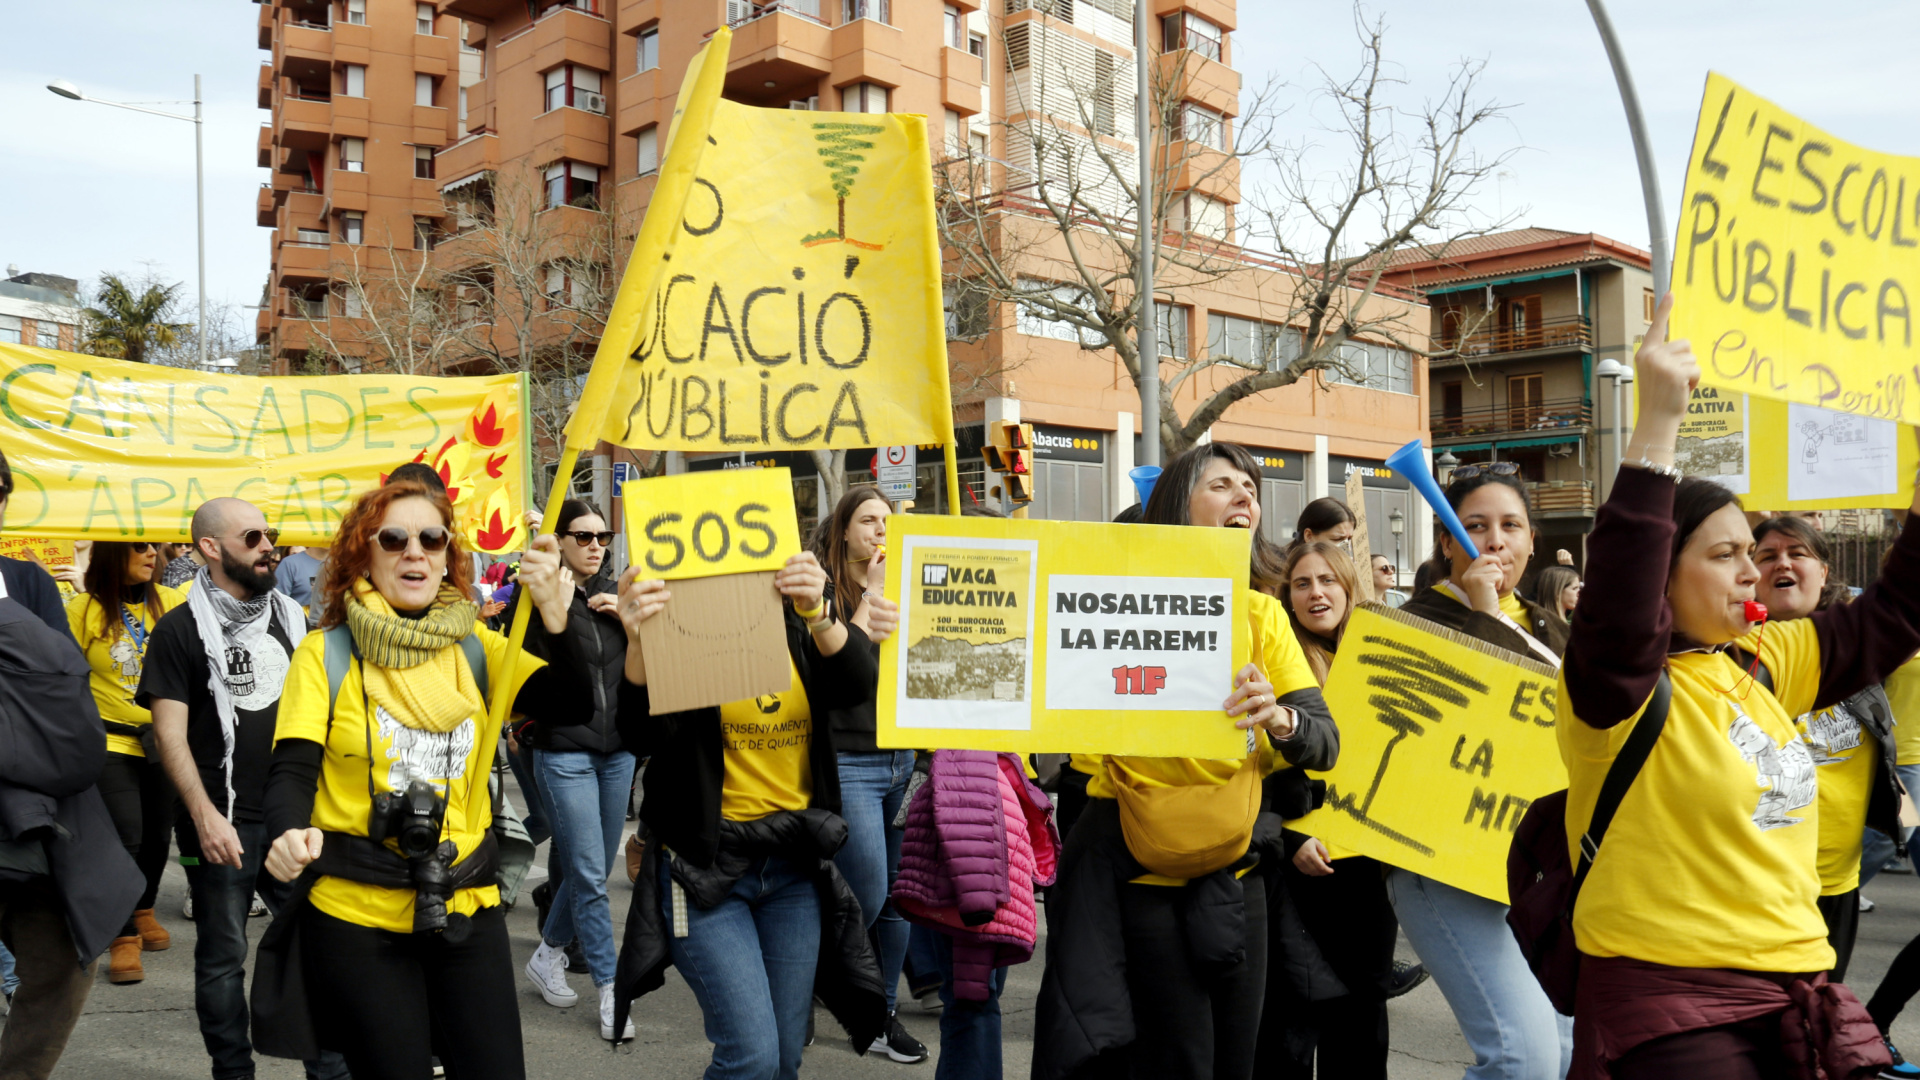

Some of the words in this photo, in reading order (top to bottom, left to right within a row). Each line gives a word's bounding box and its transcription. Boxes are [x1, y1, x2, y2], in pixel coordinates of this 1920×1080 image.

[630, 256, 872, 369] UCACIÓ
[1692, 387, 1718, 399] AGA
[0, 363, 441, 456] CANSADES
[1687, 401, 1735, 414] CATIVA
[1032, 431, 1073, 448] Abacus
[723, 461, 755, 470] Abaus
[645, 502, 777, 571] SOS
[924, 564, 948, 585] 11F
[949, 566, 997, 585] VAGA
[922, 588, 1018, 608] EDUCATIVA
[1055, 591, 1226, 617] NOSALTRES
[936, 616, 952, 624] SOU
[936, 625, 973, 633] RECURSOS
[1060, 628, 1097, 650] LA
[1103, 629, 1218, 651] FAREM!
[1112, 665, 1167, 695] 11F
[722, 719, 808, 735] ENSENYAMENT
[749, 738, 765, 750] DE
[1450, 733, 1494, 779] LA
[1463, 786, 1533, 835] MIT
